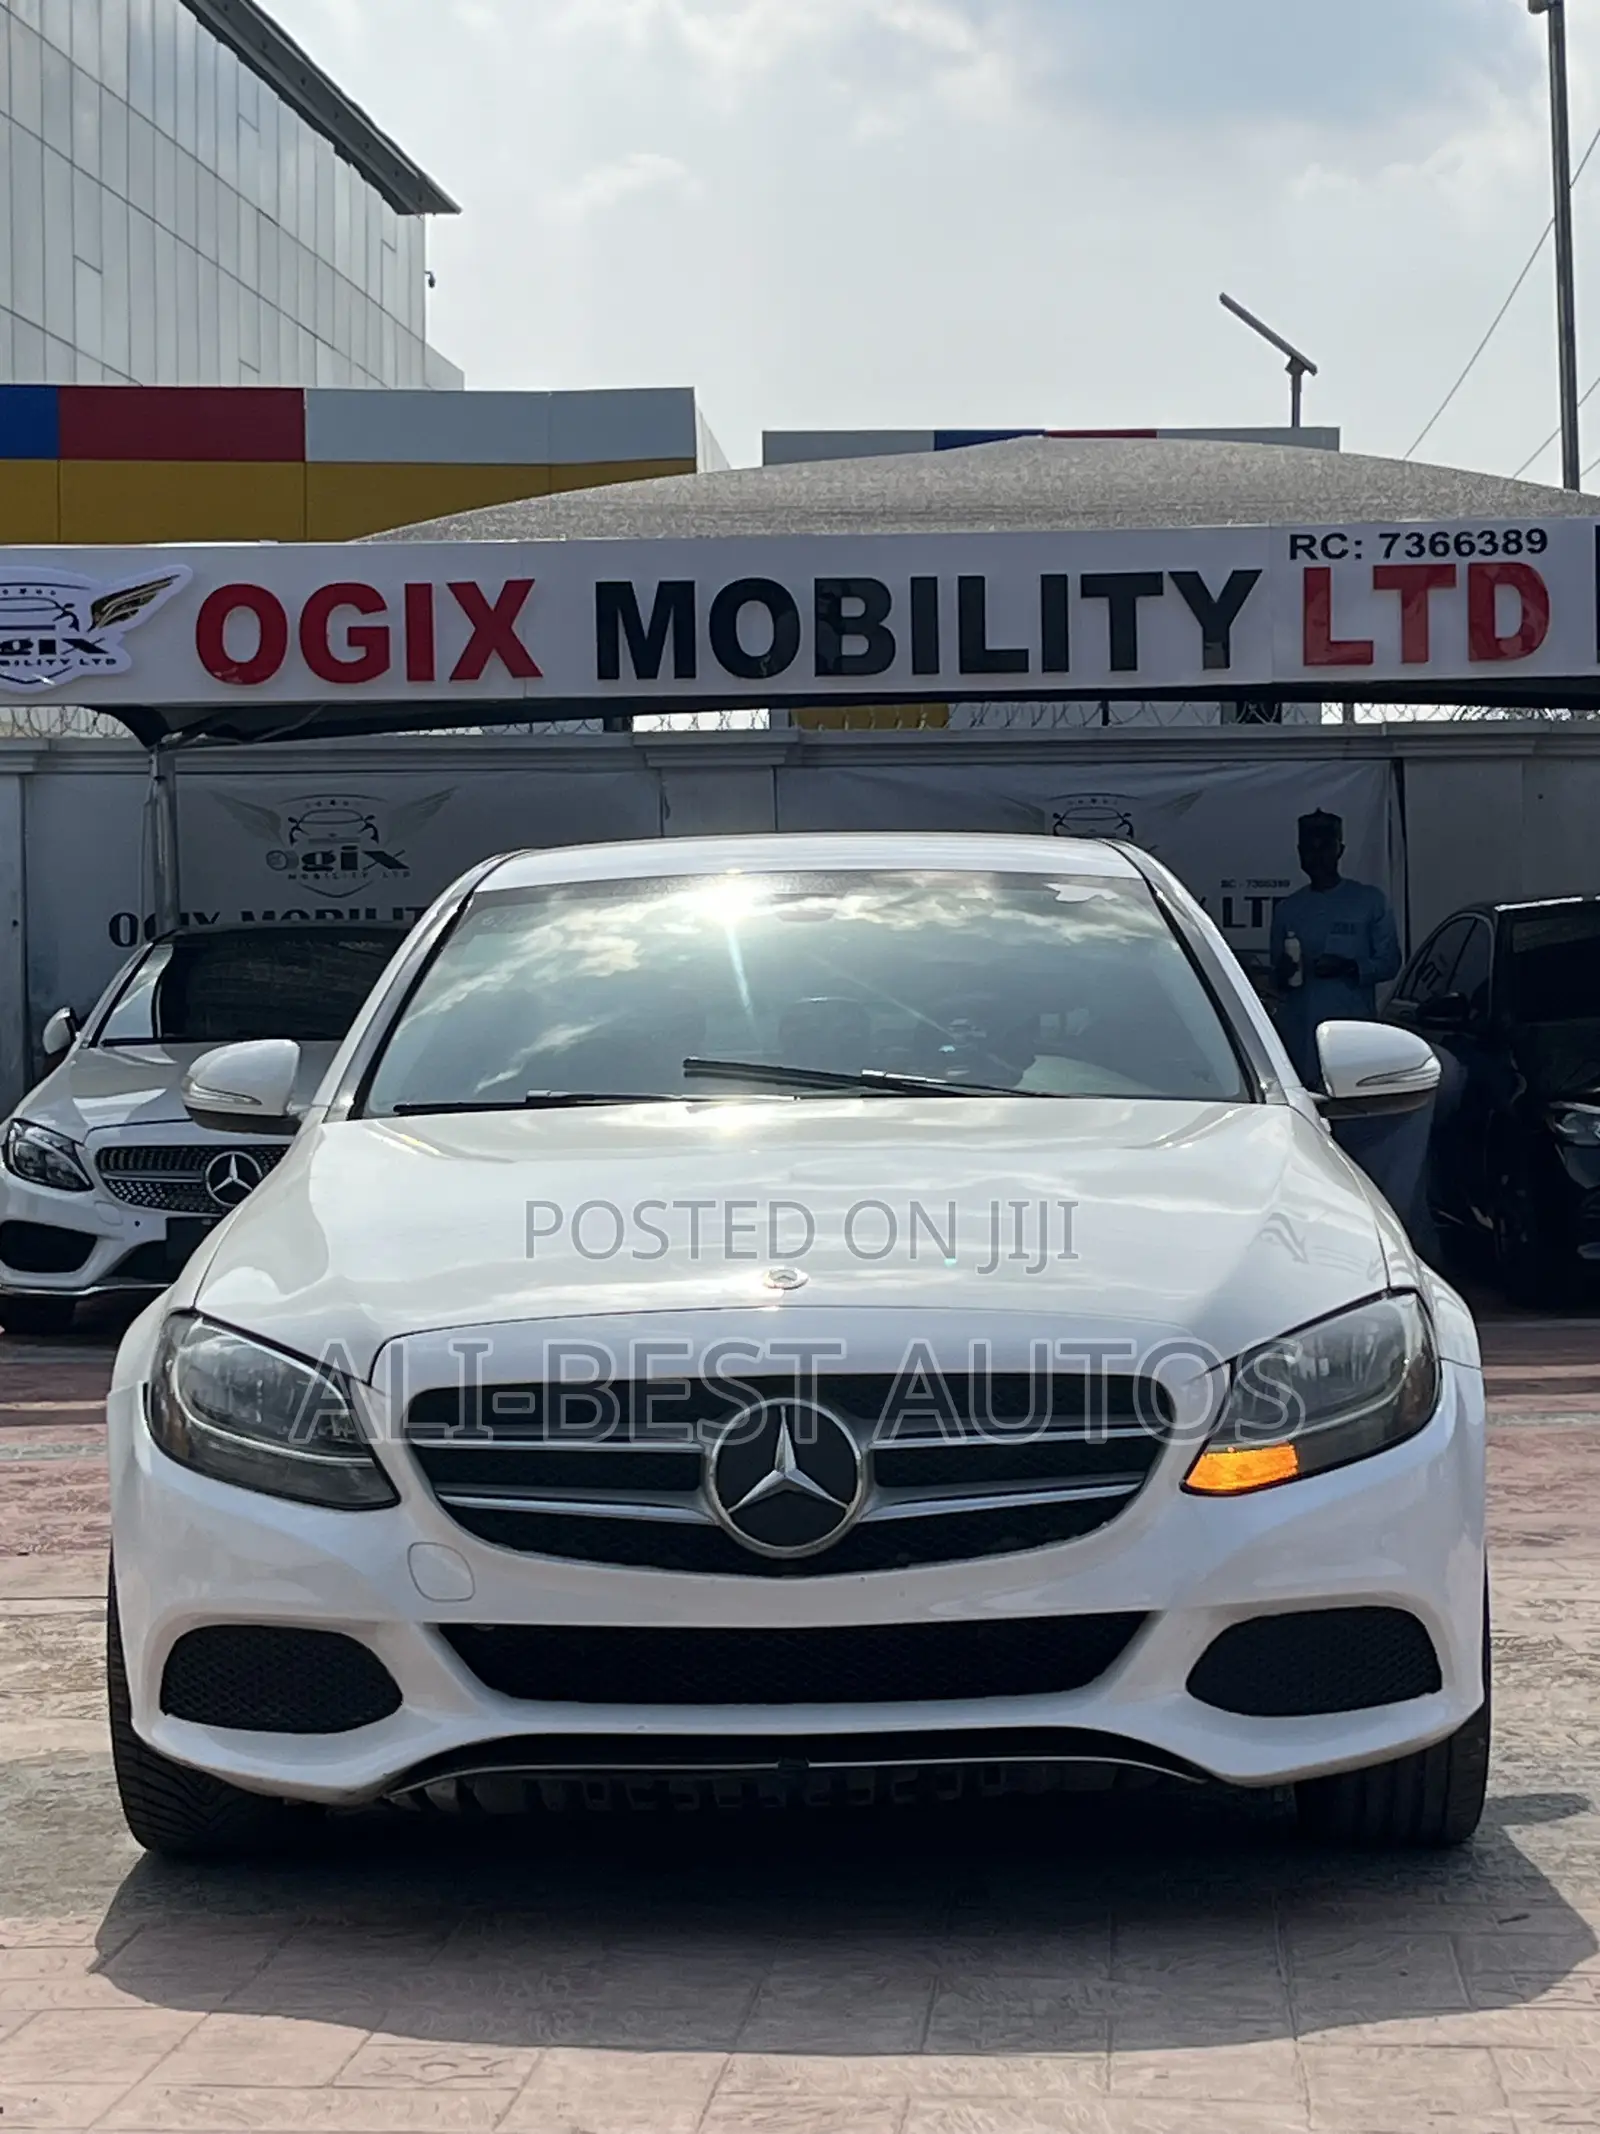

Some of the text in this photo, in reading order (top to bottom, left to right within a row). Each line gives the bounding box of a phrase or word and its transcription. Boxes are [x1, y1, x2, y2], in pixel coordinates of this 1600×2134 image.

[1289, 528, 1548, 560] RC: 7366389
[196, 578, 543, 686] OGIX
[595, 568, 1263, 681] MOBILITY
[1303, 561, 1550, 666] LTD
